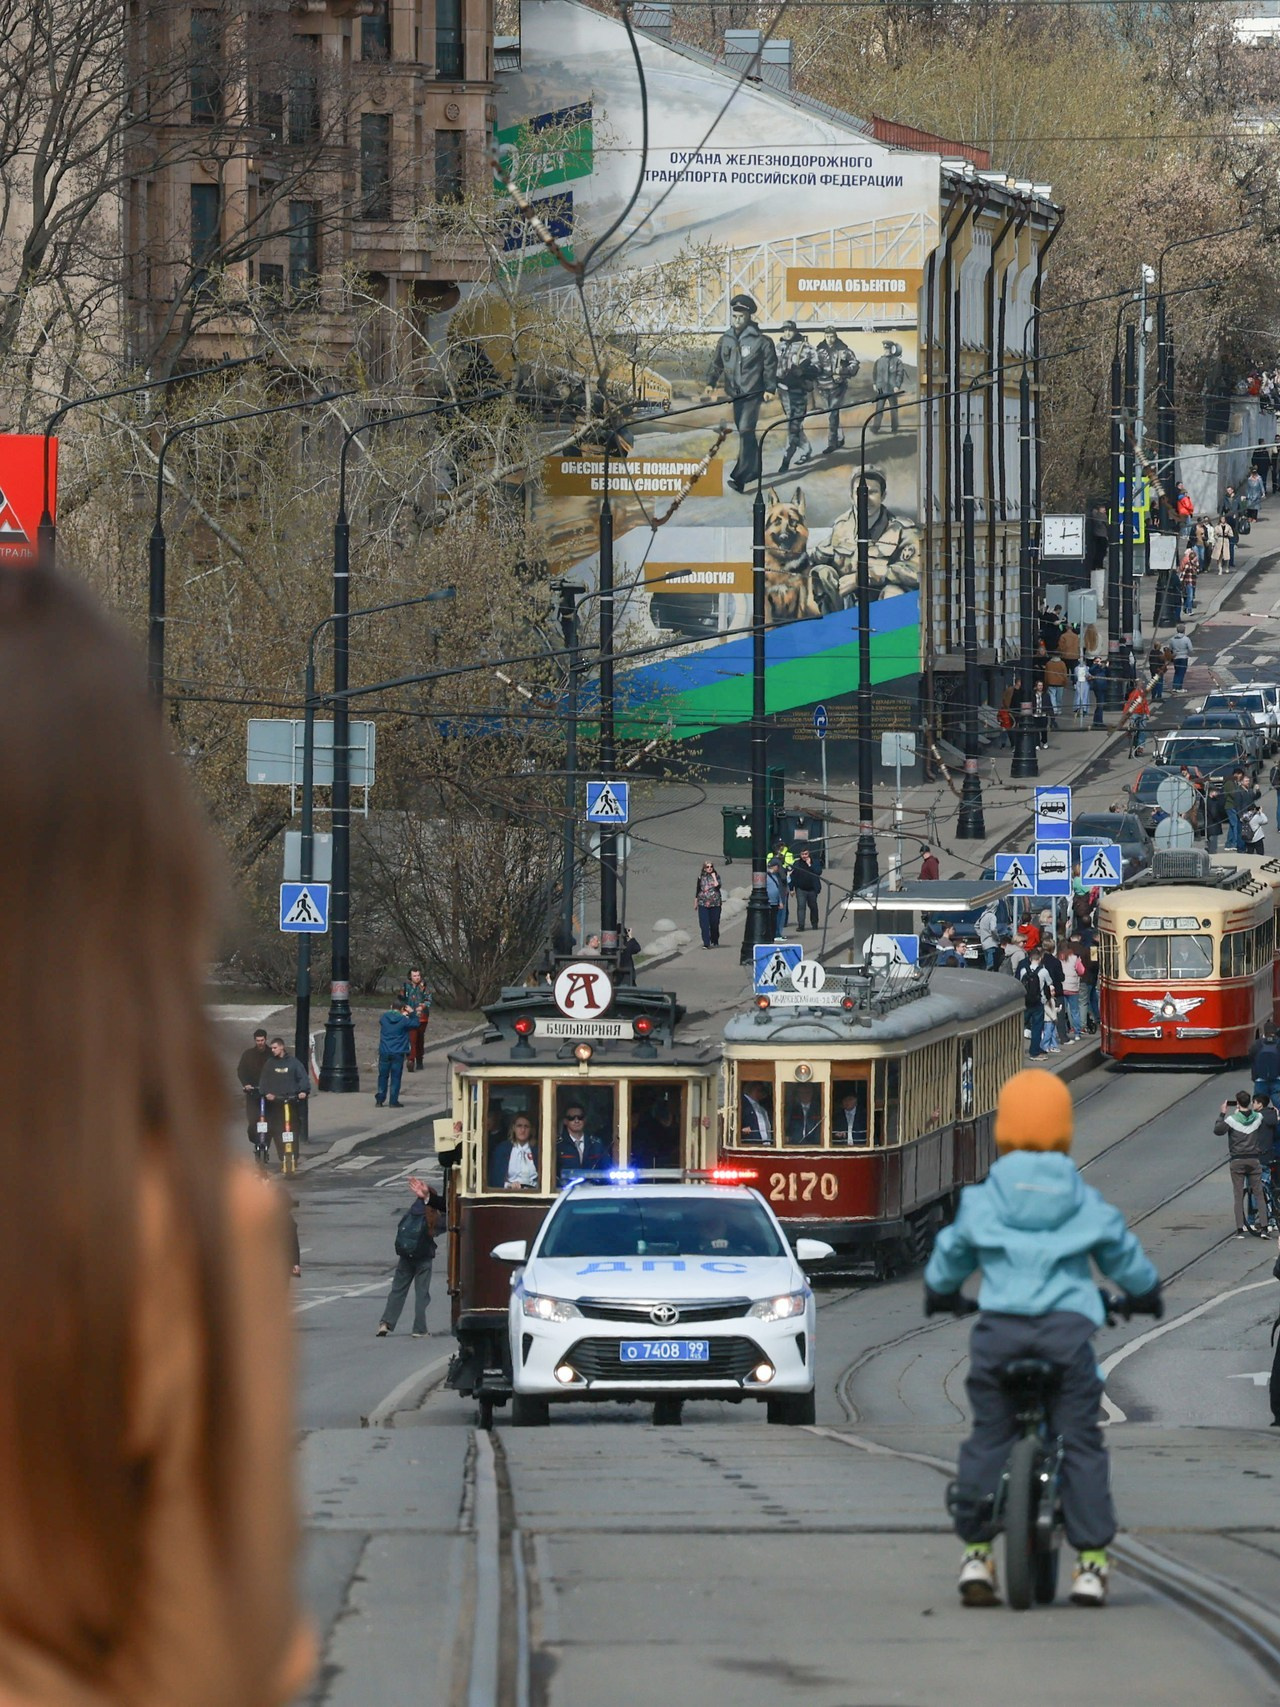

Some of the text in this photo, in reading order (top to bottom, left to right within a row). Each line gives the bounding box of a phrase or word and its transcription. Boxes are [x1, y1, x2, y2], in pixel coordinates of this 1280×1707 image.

[670, 152, 873, 169] ОХРАНА ЖЕЛЕЗНОДОРОЖНОГО
[643, 169, 904, 189] ТРАНСПОРТА РОССИЙСКОЙ ФЕДЕРАЦИИ
[798, 278, 843, 292] ОХРАНА
[797, 965, 817, 988] 41
[565, 973, 601, 1009] А
[546, 1023, 622, 1036] БУЛЬВАРНАЯ
[769, 1172, 839, 1201] 2170
[576, 1260, 748, 1275] ДПС
[642, 1343, 680, 1358] 7408
[688, 1342, 704, 1354] 99
